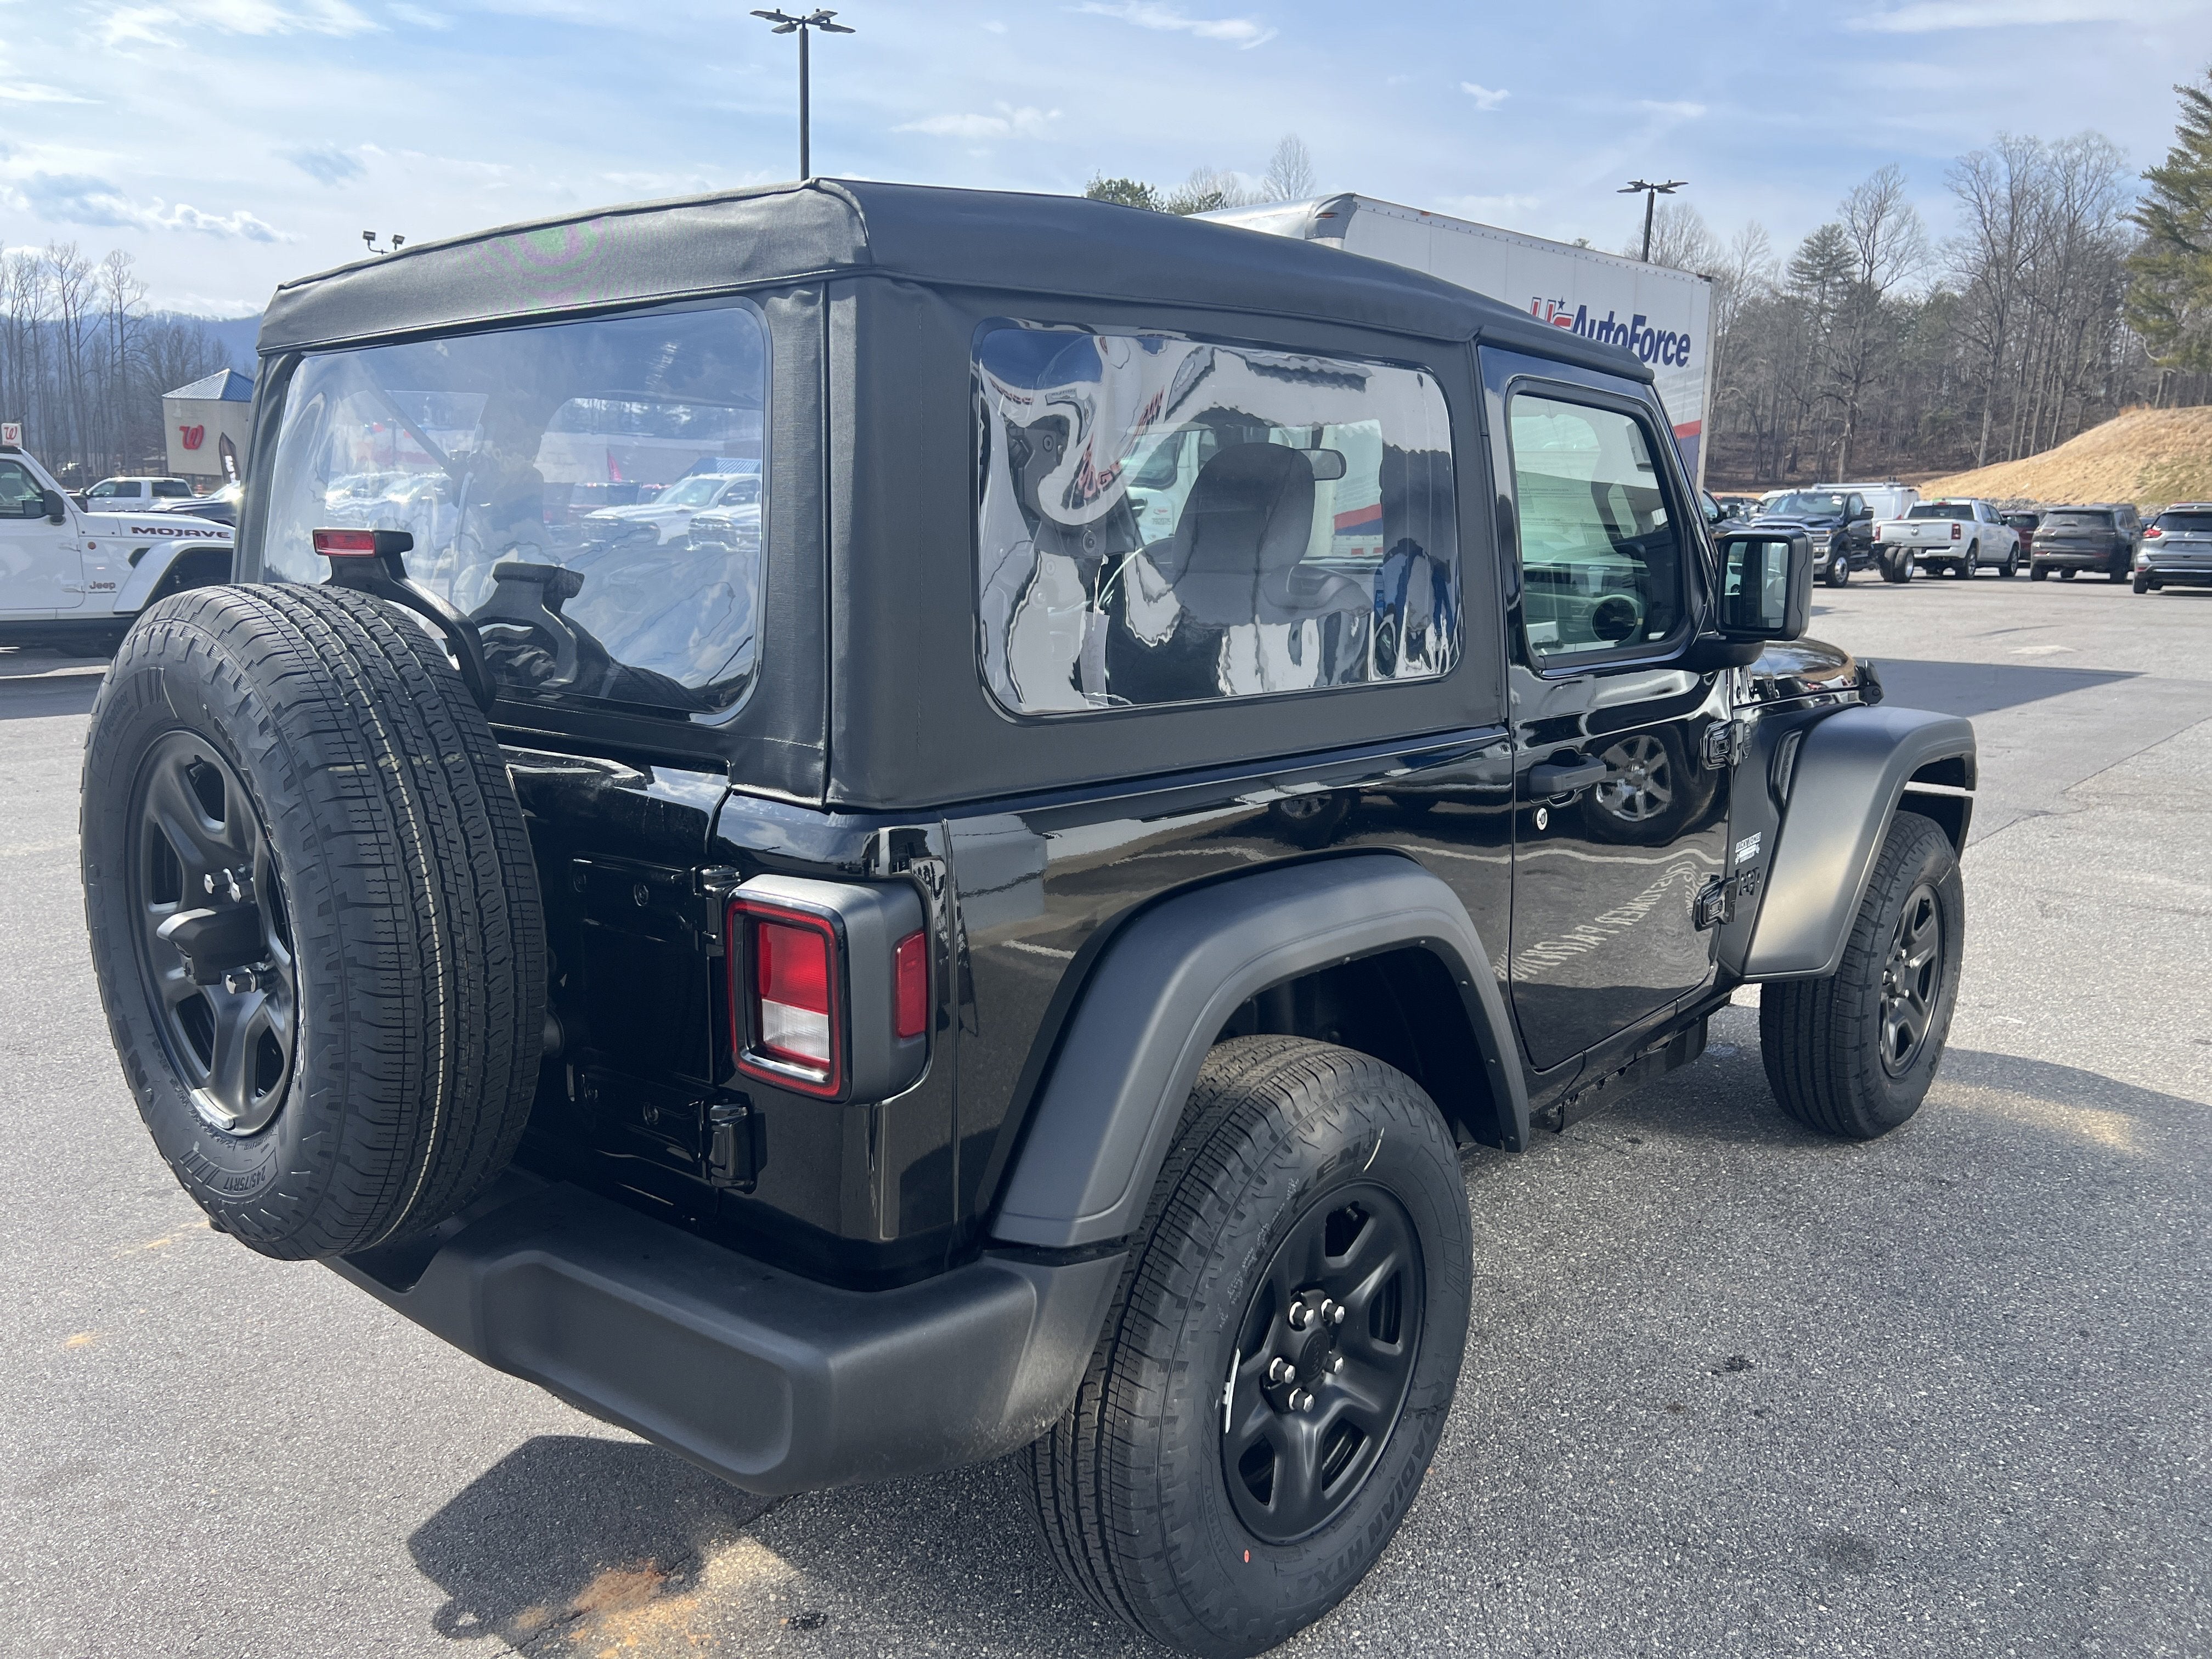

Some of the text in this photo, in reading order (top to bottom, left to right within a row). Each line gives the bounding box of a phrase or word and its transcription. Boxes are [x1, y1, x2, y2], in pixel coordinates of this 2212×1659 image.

[131, 526, 231, 539] MOJAVE
[89, 580, 116, 590] Jeep
[223, 1164, 267, 1193] 245/75R17
